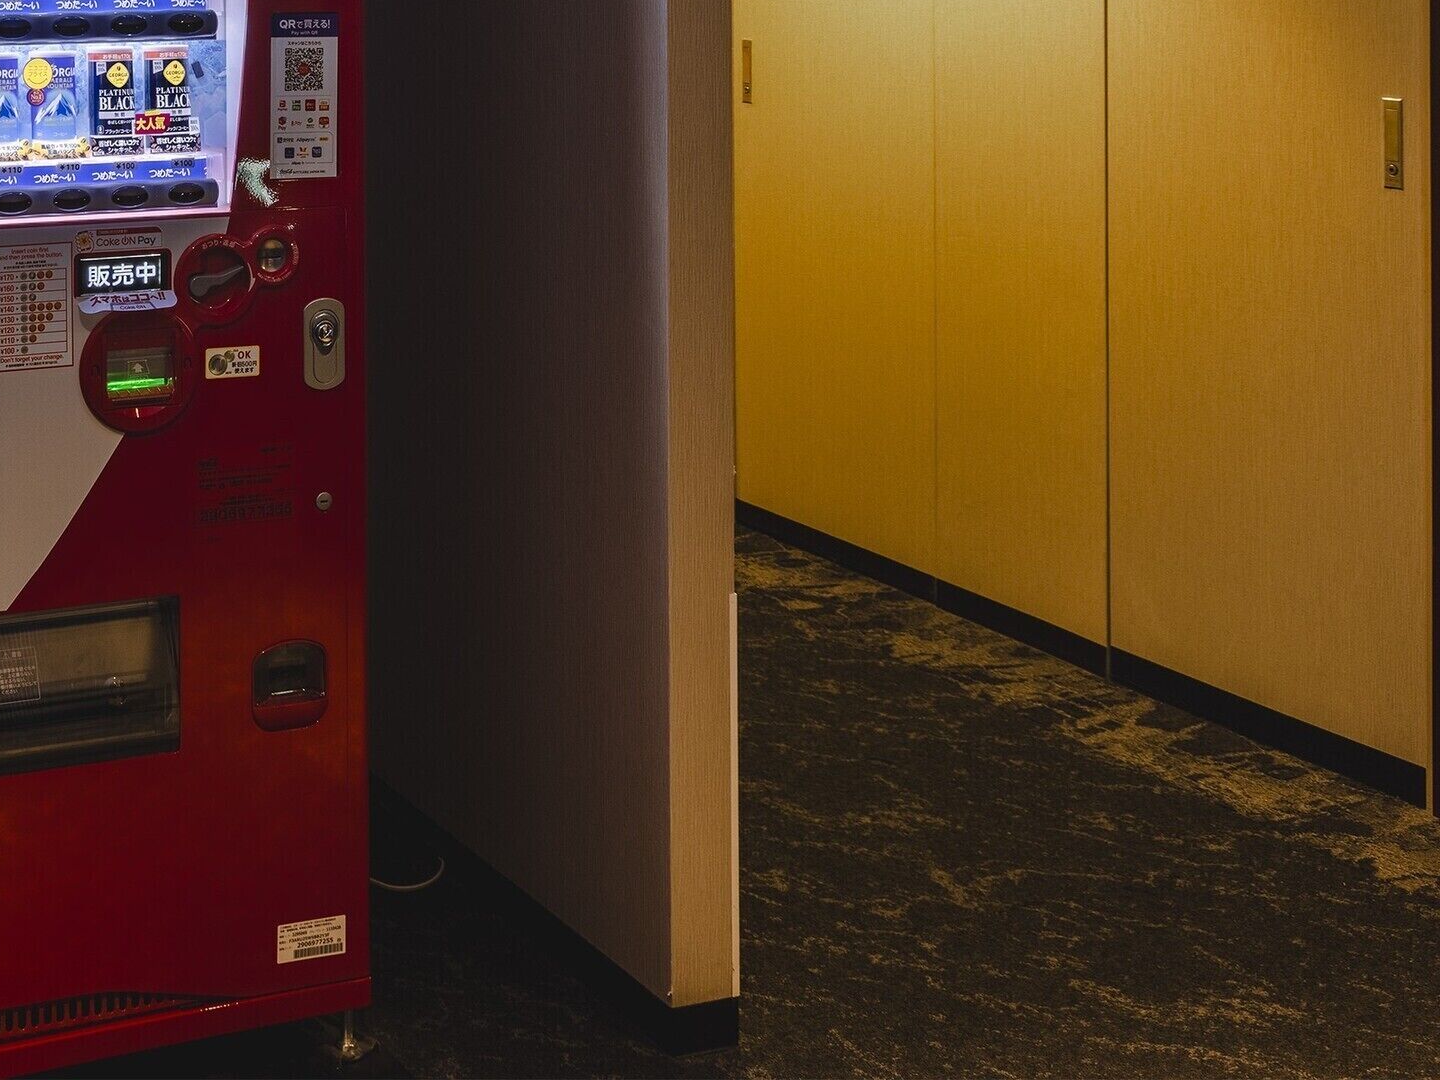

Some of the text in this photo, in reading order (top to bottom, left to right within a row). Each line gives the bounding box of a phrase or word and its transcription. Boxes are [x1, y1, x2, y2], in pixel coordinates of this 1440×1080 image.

[279, 19, 330, 30] QRで買える!
[136, 117, 166, 131] 大人気
[96, 238, 120, 247] Coke
[138, 236, 156, 246] Pay
[88, 261, 156, 287] 販売中
[90, 292, 166, 307] スマホはココへ!!
[238, 351, 251, 359] OK
